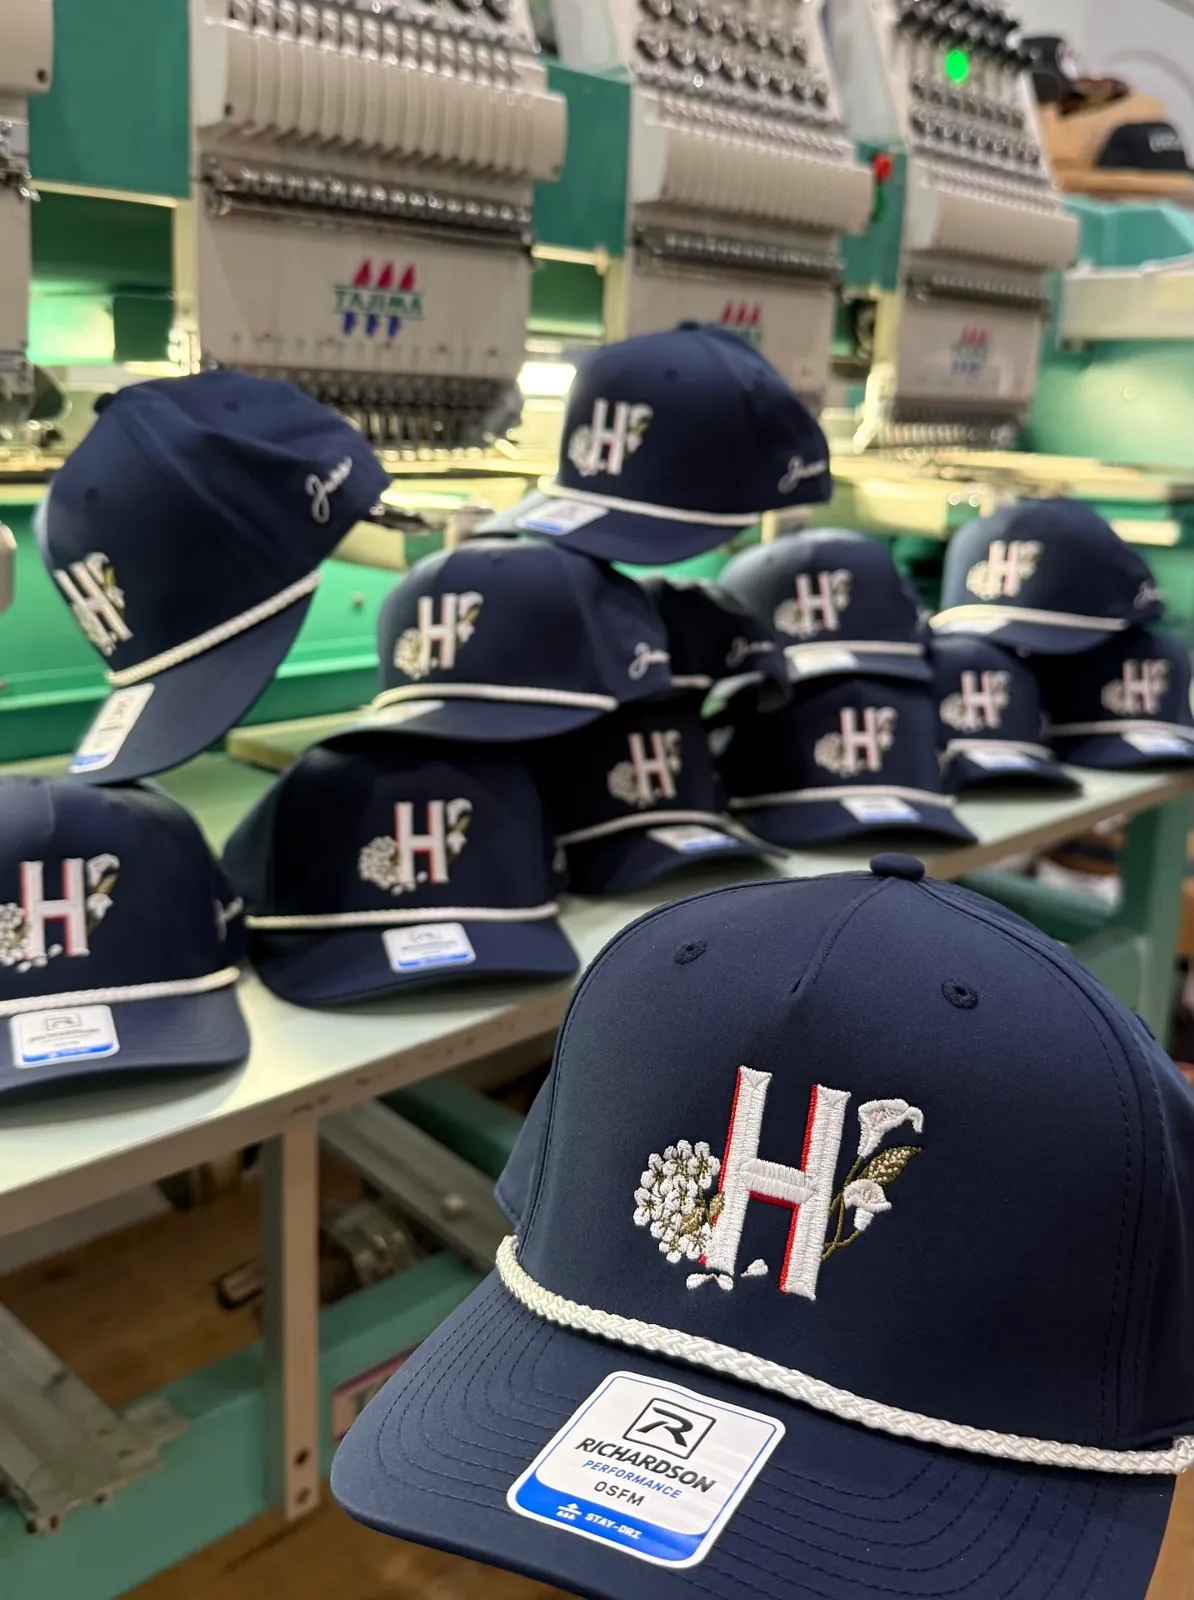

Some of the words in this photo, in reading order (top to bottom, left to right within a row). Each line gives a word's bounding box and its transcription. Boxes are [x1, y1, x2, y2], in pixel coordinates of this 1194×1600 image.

[589, 397, 628, 475] H
[988, 541, 1020, 597] H
[54, 561, 132, 650] H
[418, 593, 457, 675] H
[796, 572, 838, 635] H
[961, 670, 1000, 729] H
[630, 732, 676, 799] H
[840, 707, 880, 774] H
[395, 801, 448, 887] H
[20, 857, 91, 957] H
[700, 1065, 851, 1301] H
[574, 1437, 717, 1493] RICHARDSON
[582, 1459, 683, 1499] PERFORMANCE
[593, 1480, 645, 1507] OSFM
[584, 1512, 643, 1540] STAY-DRI
